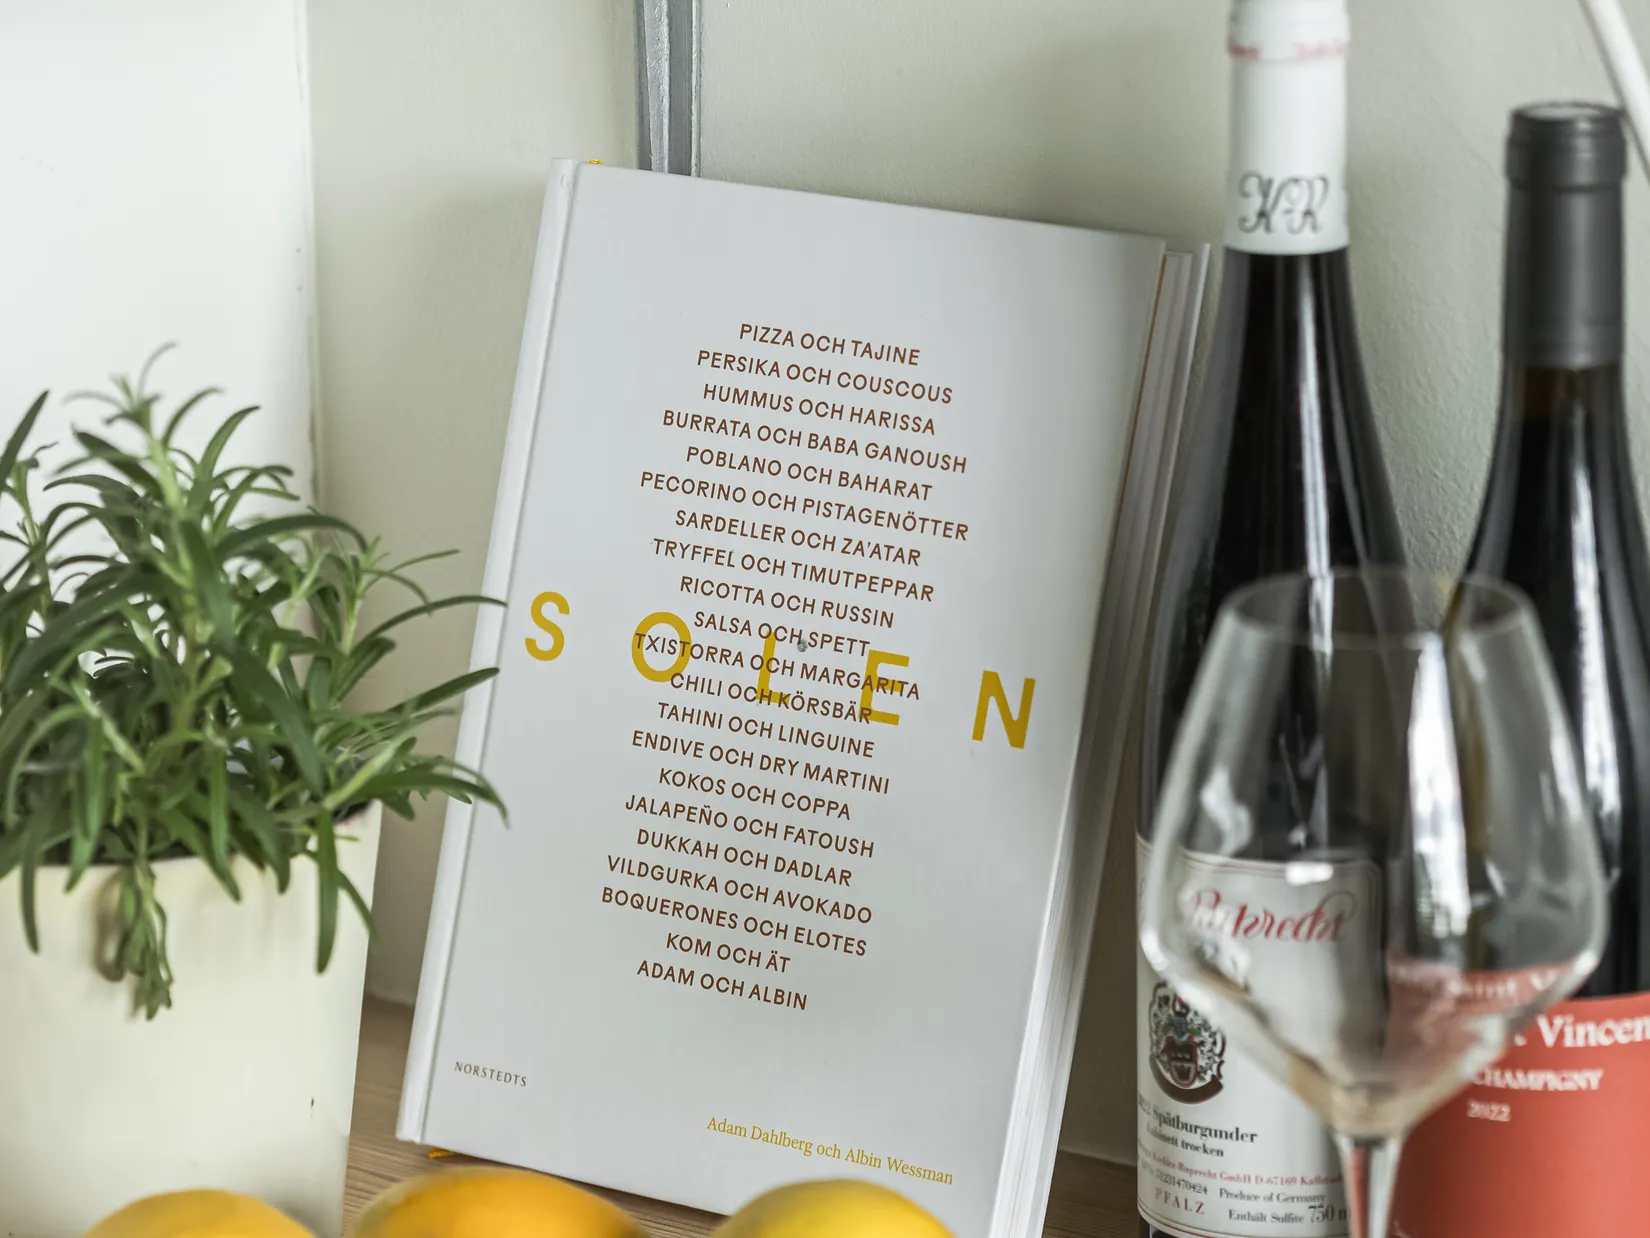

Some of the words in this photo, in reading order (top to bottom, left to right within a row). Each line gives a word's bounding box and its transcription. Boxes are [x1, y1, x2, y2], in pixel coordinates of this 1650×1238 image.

[739, 323, 795, 348] PIZZA
[800, 332, 846, 355] OCH
[851, 339, 921, 366] TAJINE
[697, 349, 781, 378] PERSIKA
[786, 363, 832, 386] OCH
[837, 371, 953, 404] COUSCOUS
[703, 383, 794, 413] HUMMUS
[798, 398, 844, 421] OCH
[849, 406, 935, 436] HARISSA
[662, 409, 751, 440] BURRATA
[757, 425, 802, 447] OCH
[807, 432, 859, 457] BABA
[864, 442, 967, 474] GANOUSH
[686, 446, 782, 477] POBLANO
[787, 462, 833, 485] OCH
[837, 470, 933, 501] BAHARAT
[640, 471, 747, 504] PECORINO
[751, 490, 797, 513] OCH
[802, 497, 969, 541] PISTAGENÖTTER
[675, 509, 786, 544] SARDELLER
[791, 529, 837, 552] OCH
[840, 537, 921, 567] ZA'ATAR
[653, 537, 736, 568] TRYFFEL
[740, 553, 786, 577] OCH
[791, 561, 934, 603] TIMUTPEPPAR
[680, 575, 765, 606] RICOTTA
[770, 592, 816, 615] OCH
[821, 600, 894, 629] RUSSIN
[693, 611, 752, 637] SALSA
[757, 622, 804, 648] OCH
[808, 631, 871, 657] SPETT
[633, 631, 744, 668] TXISTORRA
[749, 654, 795, 677] OCH
[800, 662, 920, 701] MARGARITA
[670, 671, 723, 697] CHILI
[727, 682, 773, 706] OCH
[777, 690, 873, 725] KÖRSBÄR
[657, 701, 723, 730] TAHINI
[728, 715, 774, 739] OCH
[778, 724, 875, 758] LINGUINE
[632, 729, 705, 759] ENDIVE
[709, 745, 754, 769] OCH
[759, 754, 800, 777] DRY
[803, 762, 890, 795] MARTINI
[659, 767, 726, 796] KOKOS
[731, 782, 776, 806] OCH
[781, 791, 851, 821] COPPA
[625, 794, 728, 829] JALAPEÑO
[733, 815, 779, 839] OCH
[783, 824, 875, 859] FATOUSH
[636, 828, 719, 860] DUKKAH
[723, 846, 769, 870] OCH
[773, 855, 852, 887] DADLAR
[607, 854, 719, 894] VILDGURKA
[724, 879, 770, 904] OCH
[772, 889, 872, 924] AVOKADO
[601, 886, 739, 930] BOQUERONES
[743, 916, 789, 941] OCH
[793, 926, 867, 957] ELOTES
[666, 932, 712, 958] KOM
[716, 943, 762, 968] OCH
[764, 949, 791, 973] ÄT
[636, 959, 695, 987] ADAM
[700, 973, 745, 997] OCH
[747, 983, 808, 1011] ALBIN
[453, 1060, 528, 1088] NORSTEDTS
[706, 1115, 748, 1139] Adam
[750, 1125, 814, 1157] Dahlberg
[816, 1143, 841, 1160] och
[844, 1147, 882, 1169] Albin
[886, 1156, 954, 1186] Wessman
[1153, 1107, 1258, 1143] Spätburgunder
[1180, 1139, 1225, 1158] trocken
[1219, 1187, 1261, 1203] Produce
[1263, 1190, 1276, 1202] of
[1276, 1189, 1326, 1205] Germany
[1307, 1204, 1336, 1224] 750
